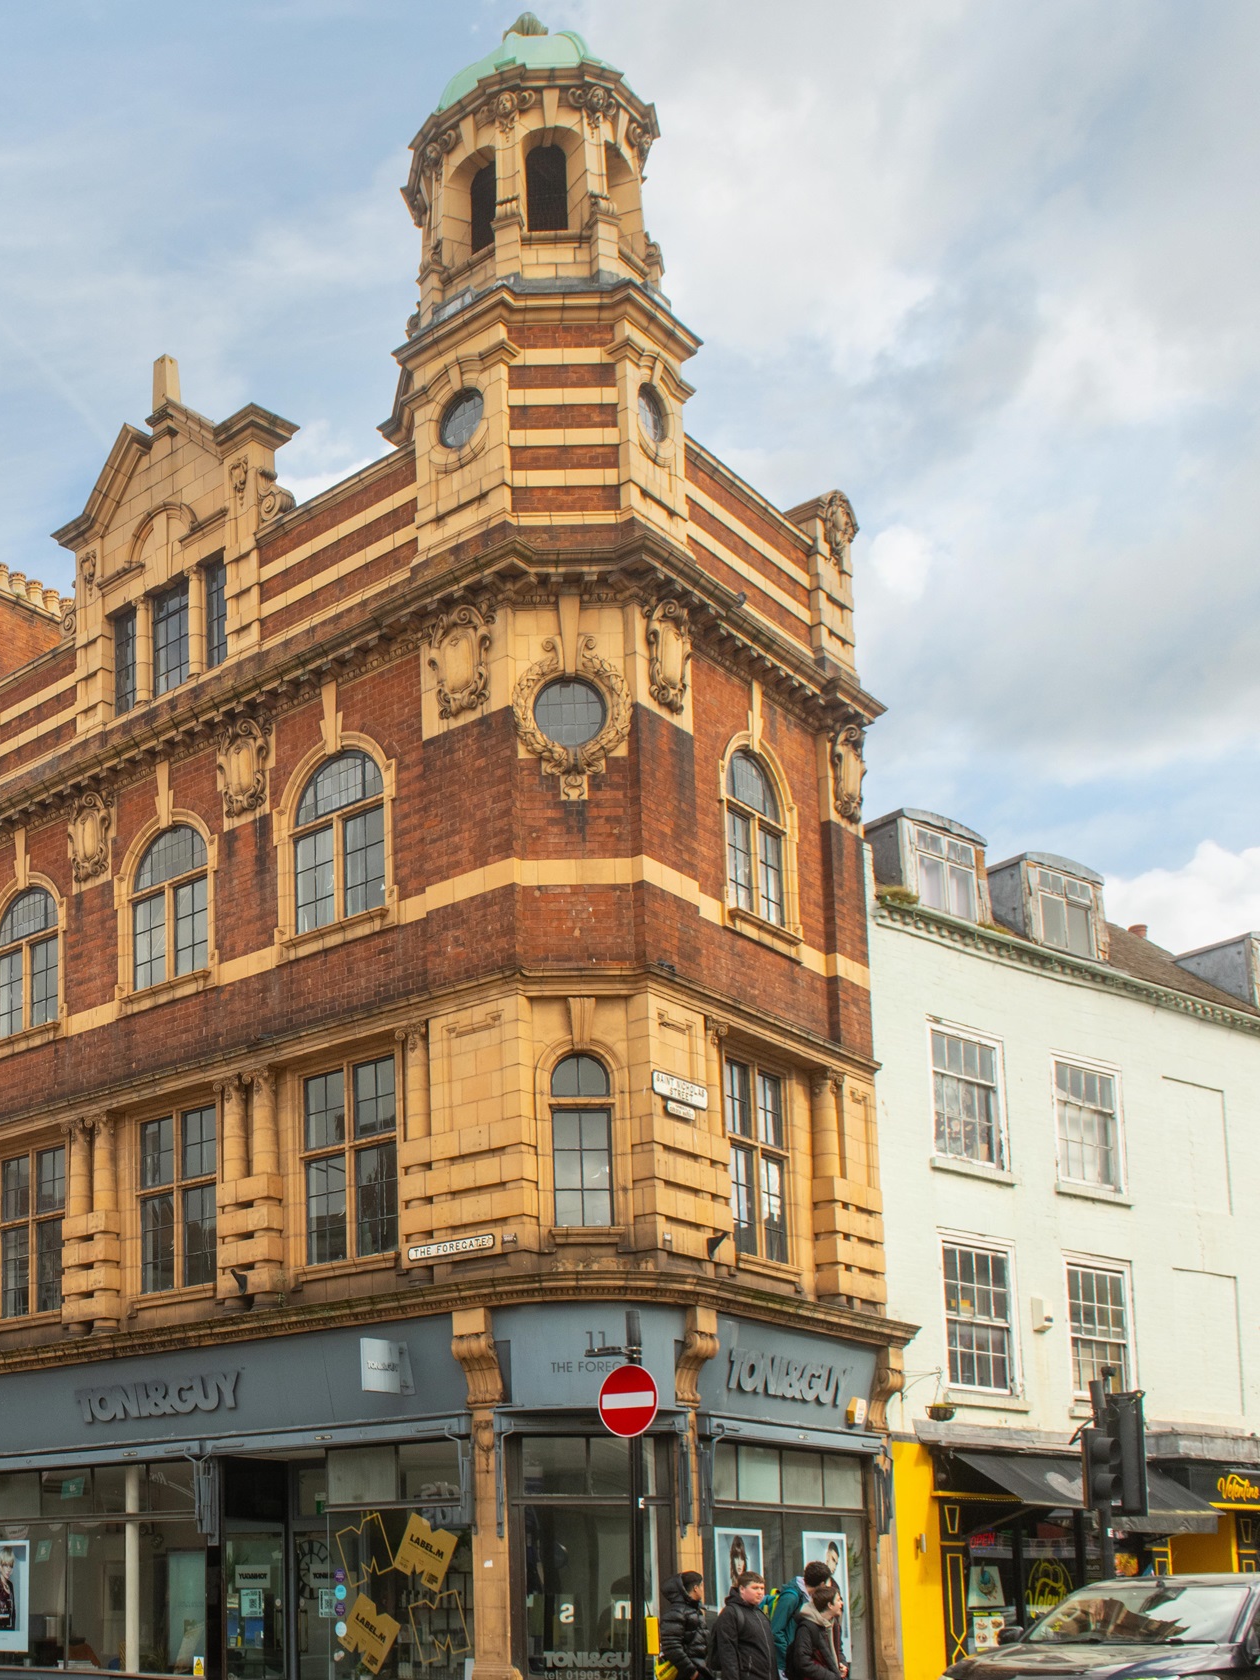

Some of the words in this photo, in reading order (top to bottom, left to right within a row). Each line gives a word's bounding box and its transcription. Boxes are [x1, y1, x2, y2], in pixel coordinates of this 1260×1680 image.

[656, 1073, 675, 1086] SAINT
[676, 1080, 705, 1098] NICHOLAS
[669, 1087, 693, 1102] STREET
[414, 1246, 432, 1257] THE
[436, 1237, 487, 1254] FOREGATE
[585, 1331, 606, 1350] 11
[551, 1362, 573, 1373] THE
[578, 1361, 622, 1373] FOREG
[727, 1346, 852, 1408] TONI&GUY
[75, 1371, 240, 1424] TONI&GUY
[410, 1533, 445, 1559] LABEL.M
[970, 1532, 995, 1549] OPEN
[355, 1612, 387, 1644] LABEL.M
[543, 1651, 632, 1668] TONI&GU
[544, 1670, 564, 1680] tel:
[566, 1670, 601, 1680] 01905
[604, 1670, 631, 1680] 7311
